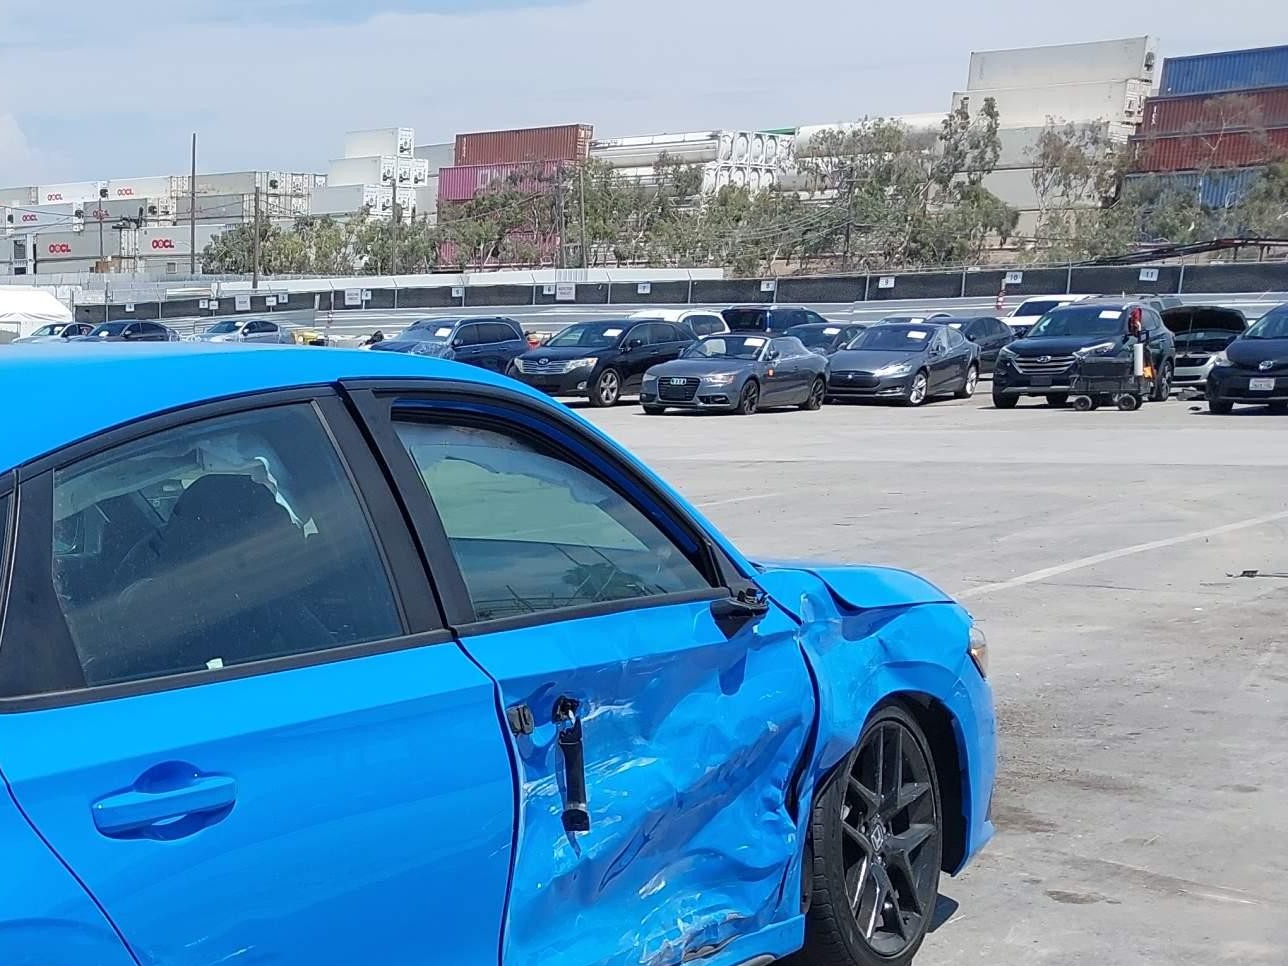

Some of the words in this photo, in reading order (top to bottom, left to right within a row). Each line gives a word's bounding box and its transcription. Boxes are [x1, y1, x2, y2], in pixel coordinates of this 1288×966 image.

[117, 188, 134, 196] OOCL
[22, 214, 38, 222] OOCL
[151, 239, 174, 249] OOCL
[49, 244, 71, 253] OOCL
